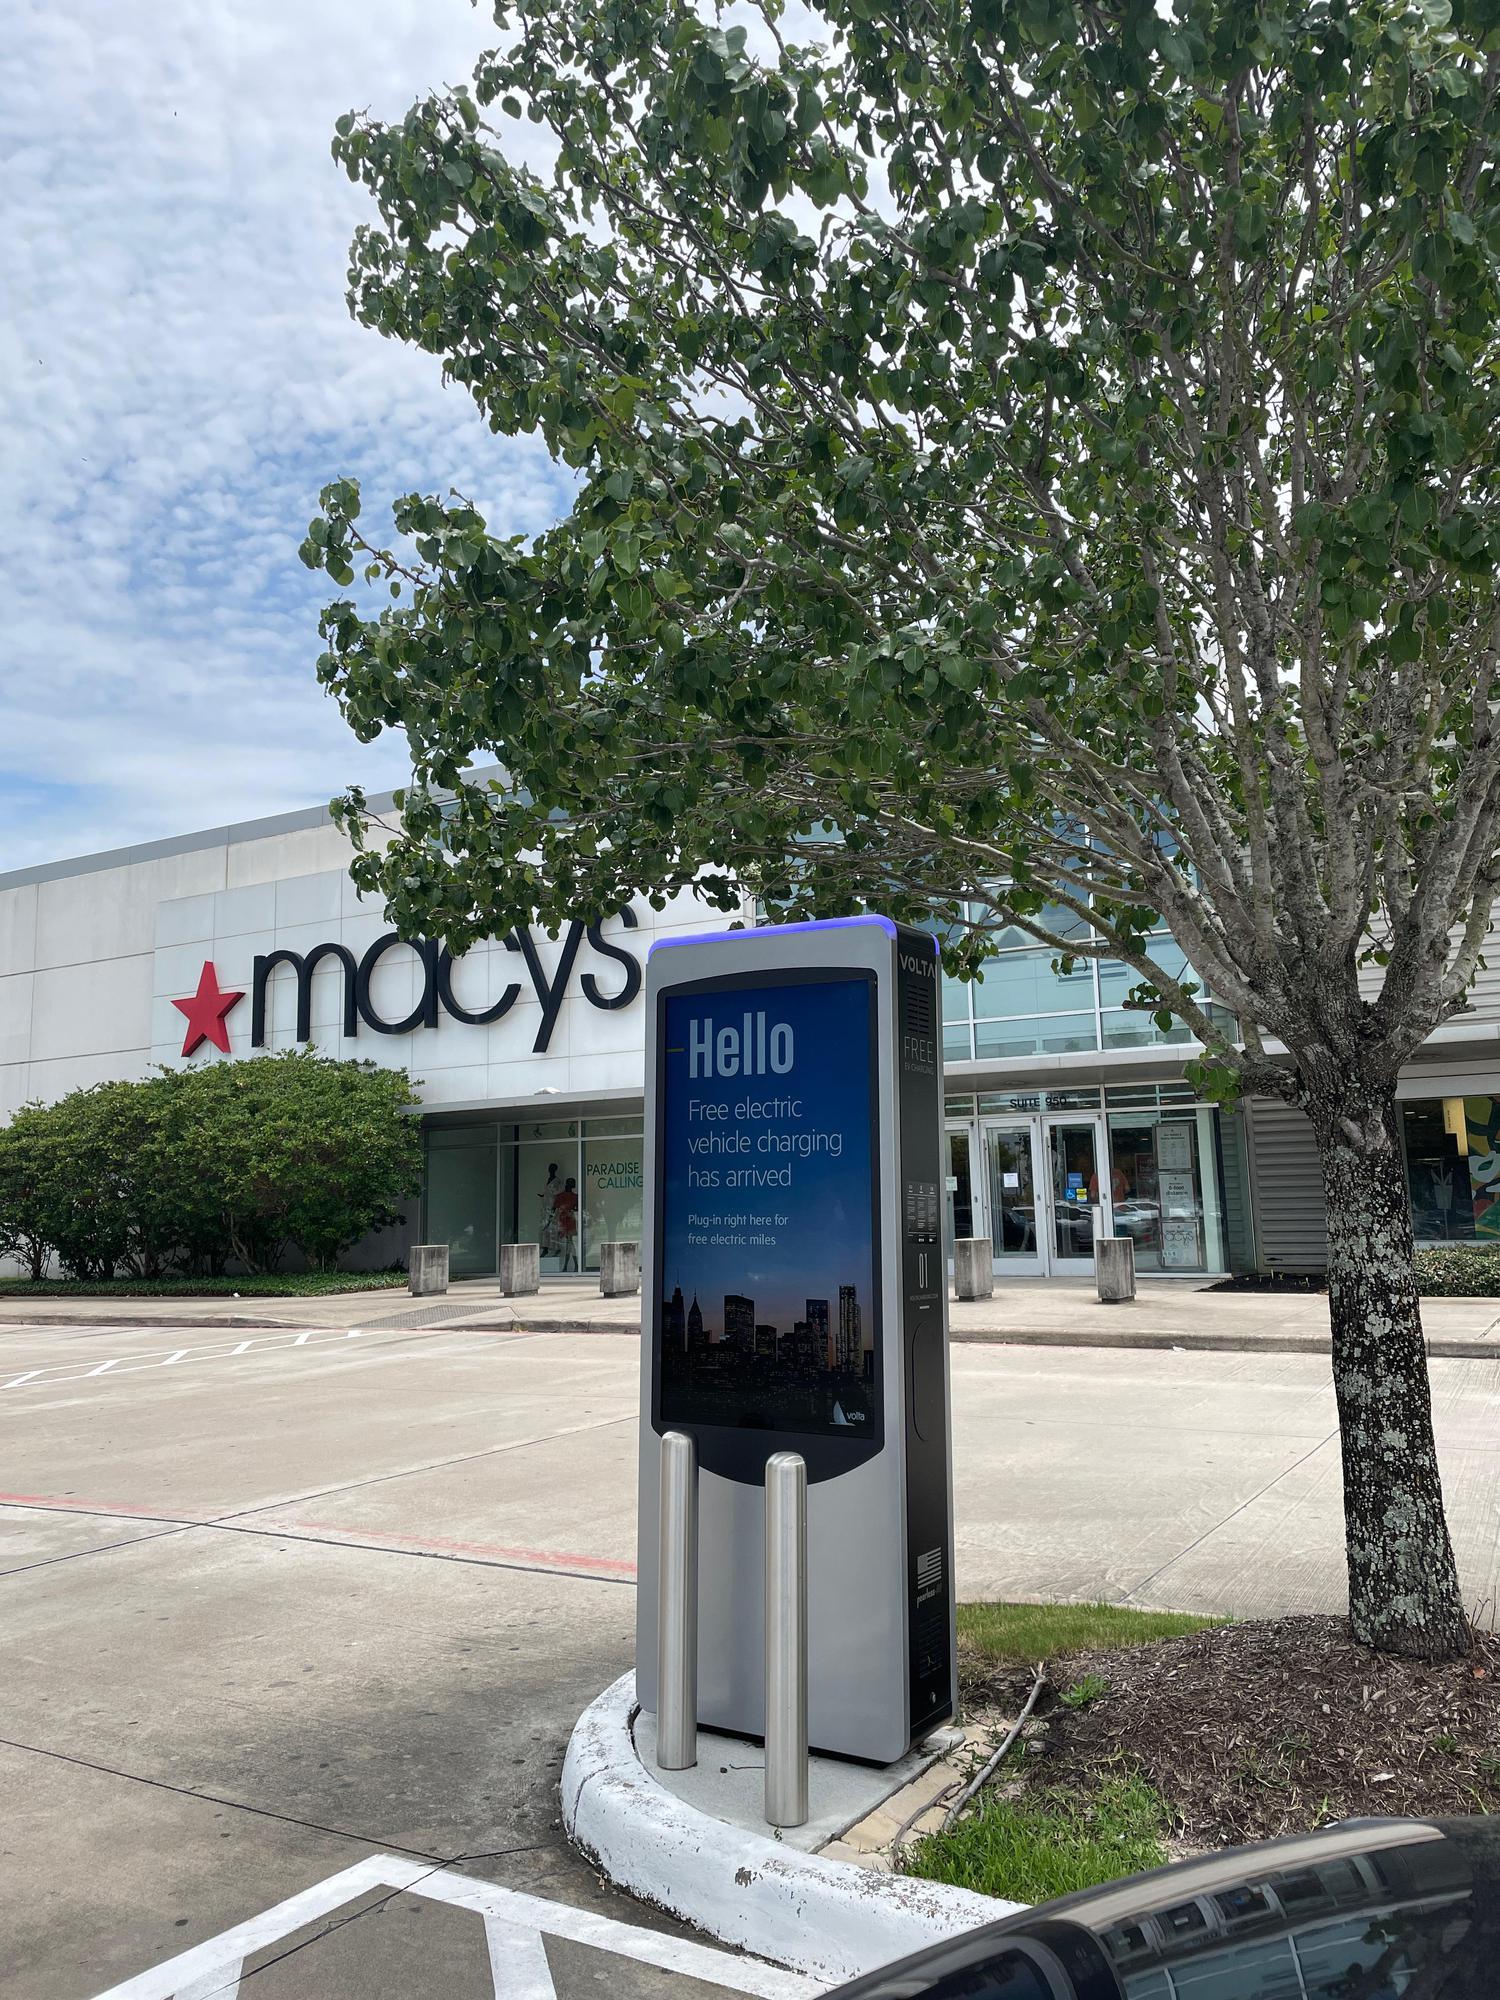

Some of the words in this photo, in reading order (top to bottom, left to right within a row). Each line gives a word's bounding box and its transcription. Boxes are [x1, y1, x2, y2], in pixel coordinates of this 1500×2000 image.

[899, 953, 935, 978] VOLTA
[689, 1011, 794, 1078] Hello
[904, 1036, 934, 1064] FREE
[689, 1099, 729, 1121] Free
[734, 1096, 803, 1120] electric
[1009, 1098, 1040, 1108] SUITE
[1045, 1096, 1067, 1106] 950
[688, 1129, 751, 1154] vehicle
[757, 1129, 842, 1157] charging
[587, 1162, 639, 1176] PARADISE
[688, 1164, 720, 1188] has
[726, 1162, 792, 1187] arrived
[598, 1176, 644, 1189] CALLING
[688, 1214, 722, 1228] Plug-in
[724, 1214, 747, 1228] right
[749, 1214, 772, 1226] here
[774, 1213, 789, 1226] for
[688, 1233, 708, 1245] free
[710, 1233, 747, 1245] electric
[749, 1233, 776, 1245] miles
[846, 1411, 865, 1421] volta
